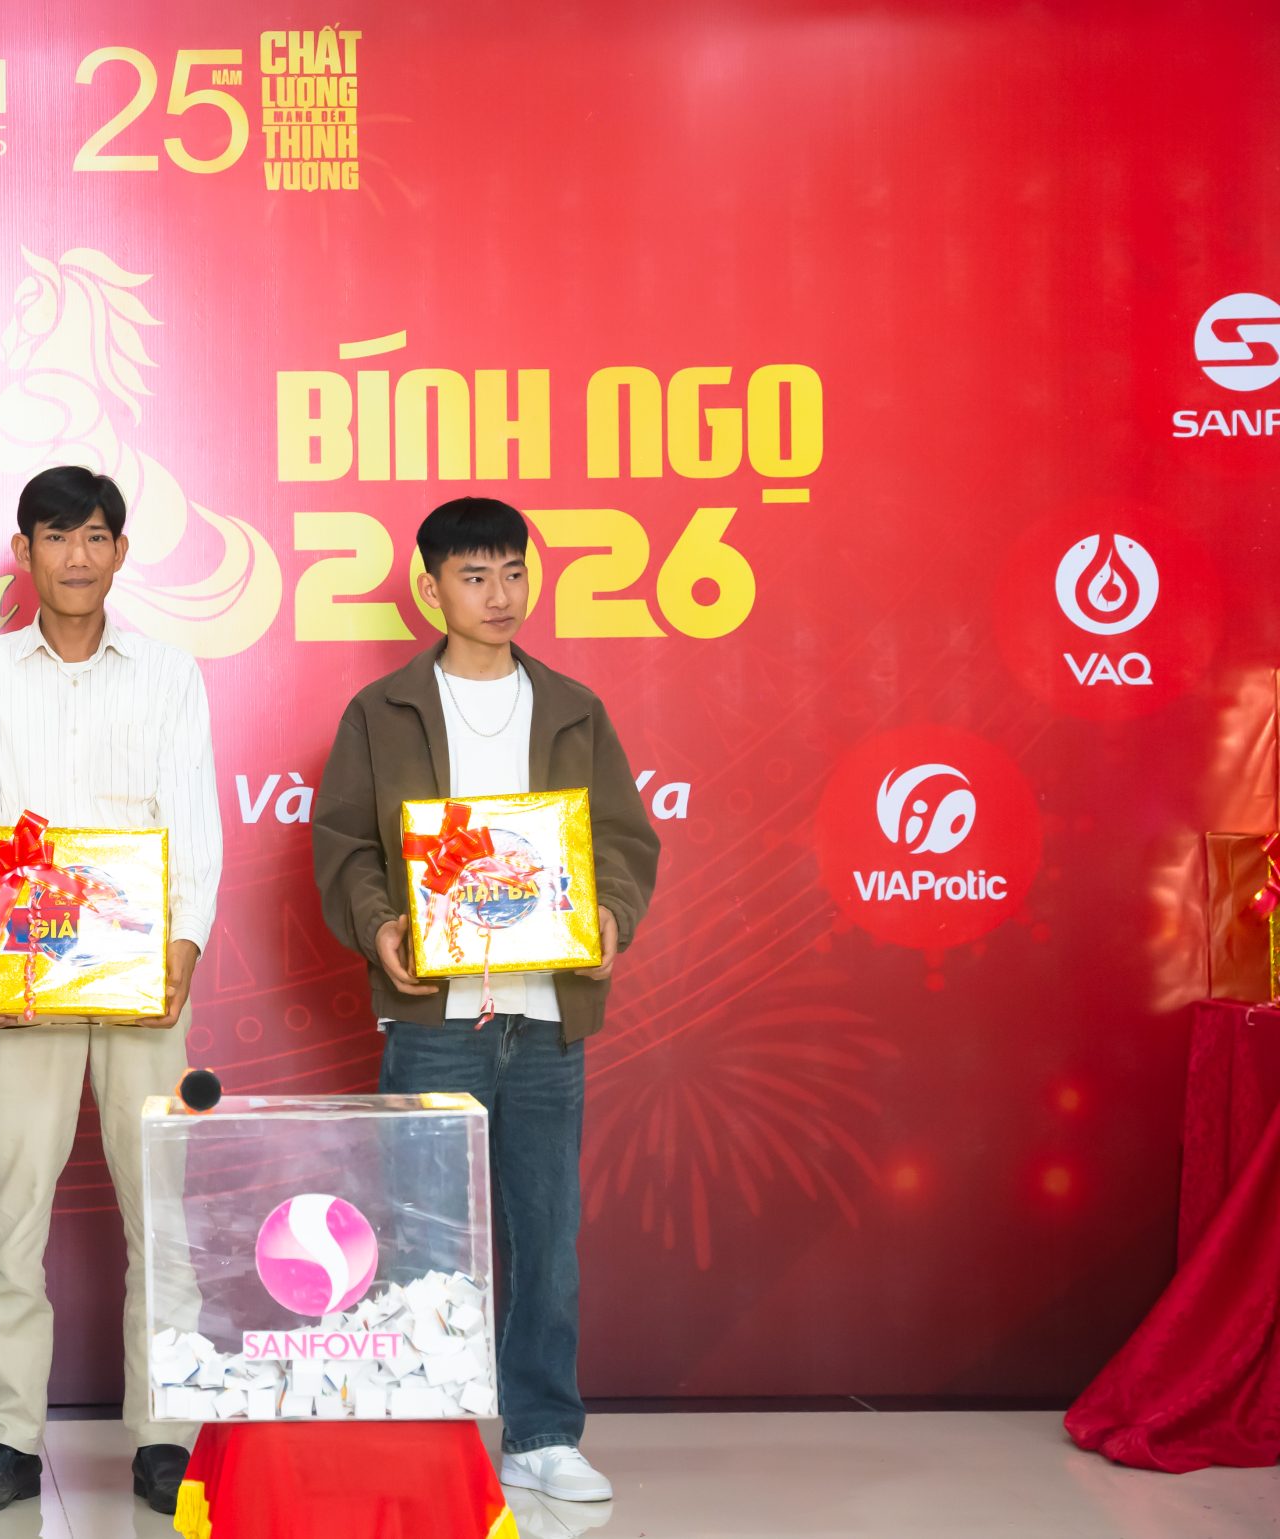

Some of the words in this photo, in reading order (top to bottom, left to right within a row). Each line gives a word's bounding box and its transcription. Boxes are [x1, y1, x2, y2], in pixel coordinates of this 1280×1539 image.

[260, 22, 362, 74] CHẤT
[73, 46, 249, 174] 25
[273, 111, 313, 123] MANG
[261, 125, 358, 161] THỊNH
[277, 330, 551, 482] BÍNH
[586, 363, 824, 504] NGỌ
[1063, 652, 1154, 686] VAQ
[235, 771, 315, 824] Và
[852, 869, 1008, 901] VIAProtic
[243, 1332, 403, 1360] SANFOVET
